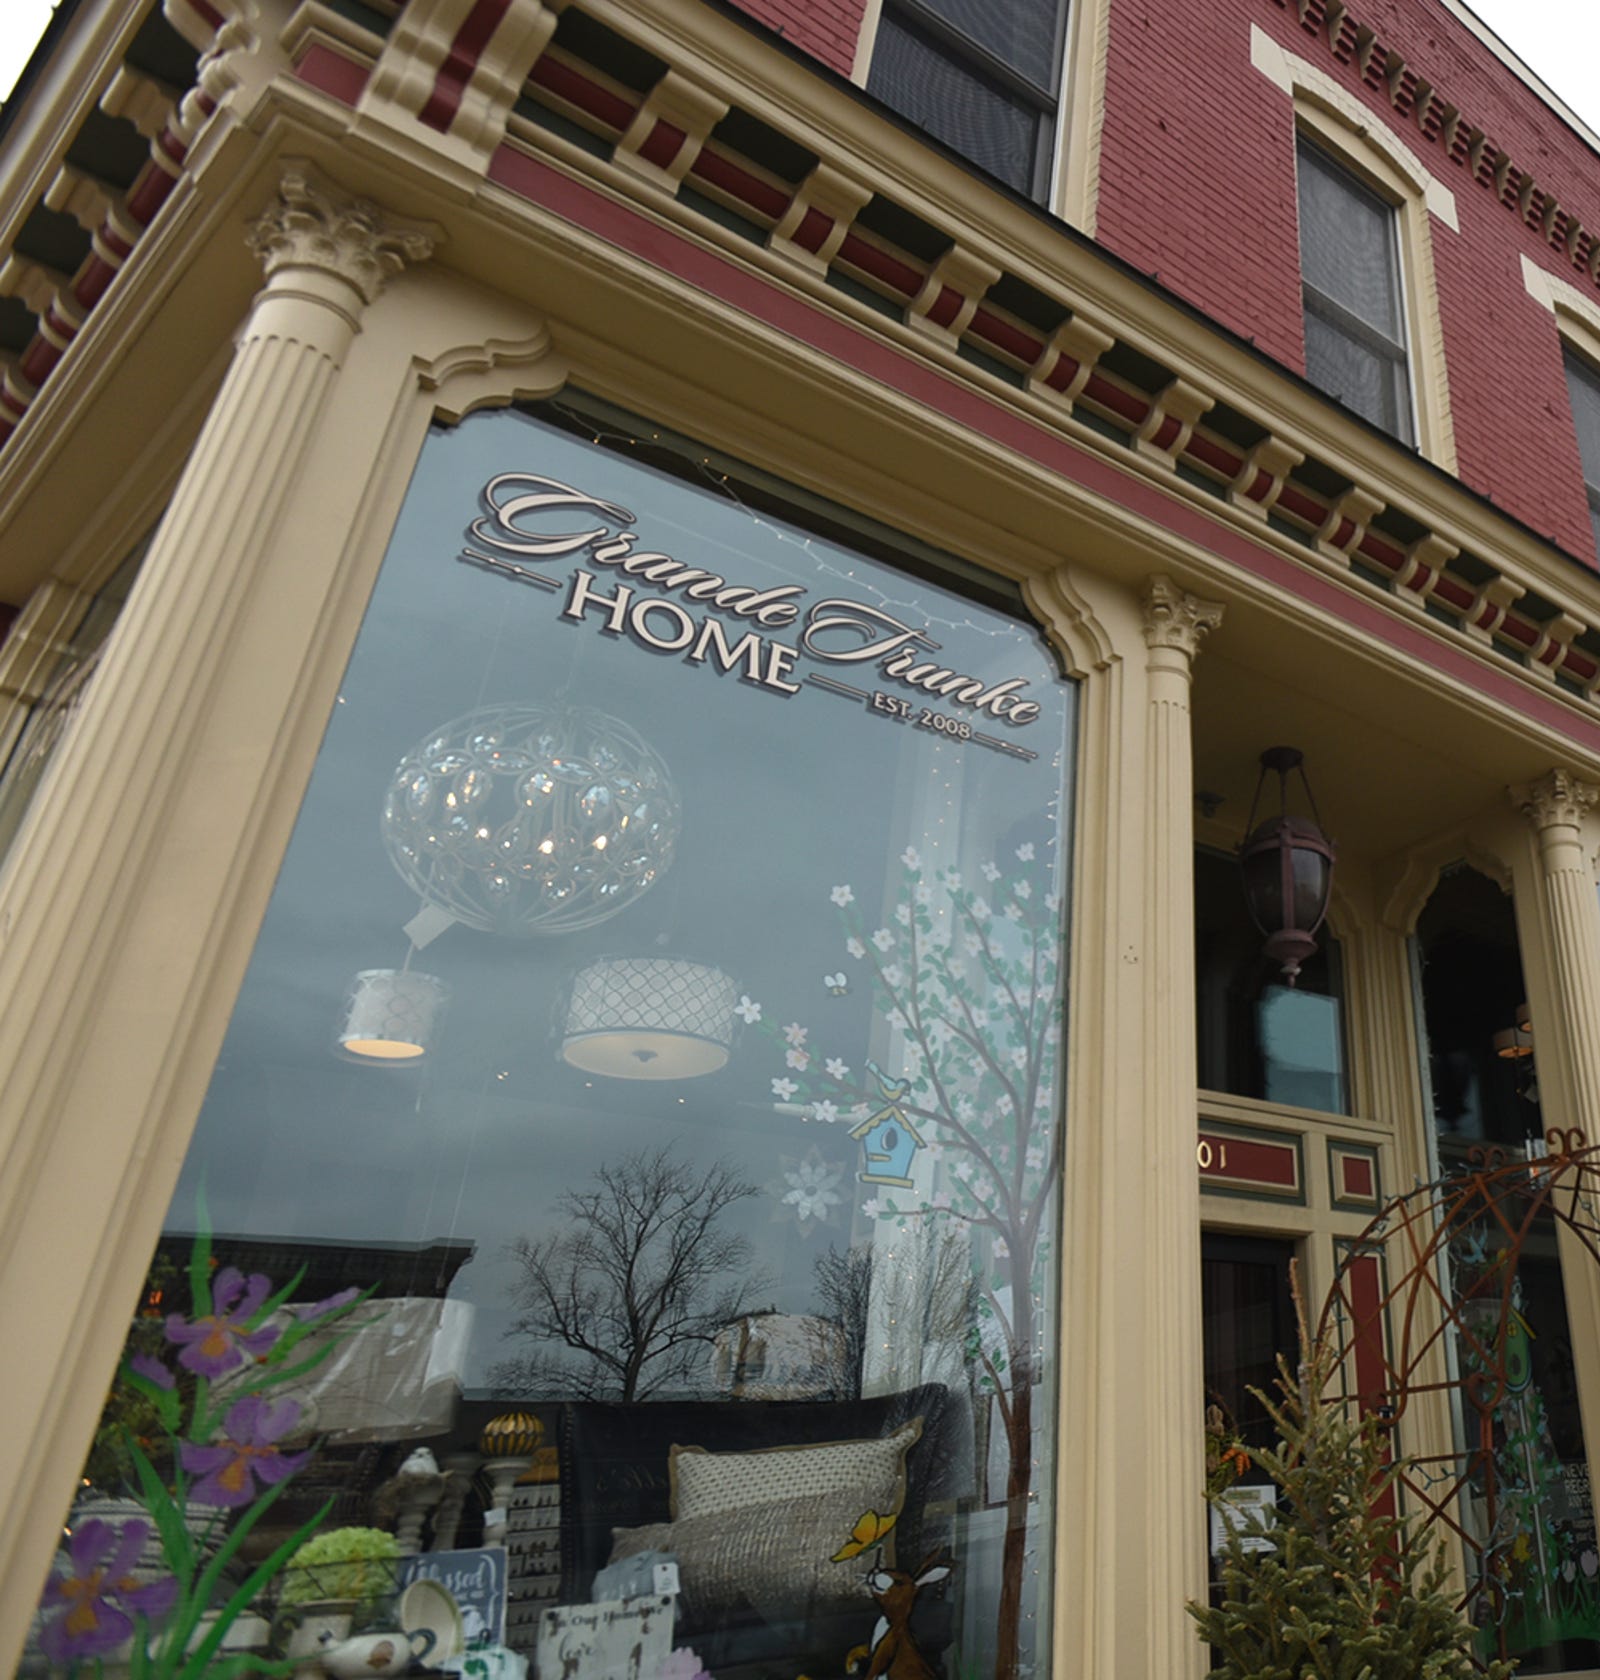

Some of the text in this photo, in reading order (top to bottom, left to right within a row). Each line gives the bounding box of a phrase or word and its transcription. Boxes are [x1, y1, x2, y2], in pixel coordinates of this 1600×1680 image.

[470, 472, 1042, 726] Grande Trunke
[563, 568, 804, 696] HOME
[872, 690, 972, 742] EST. 2008
